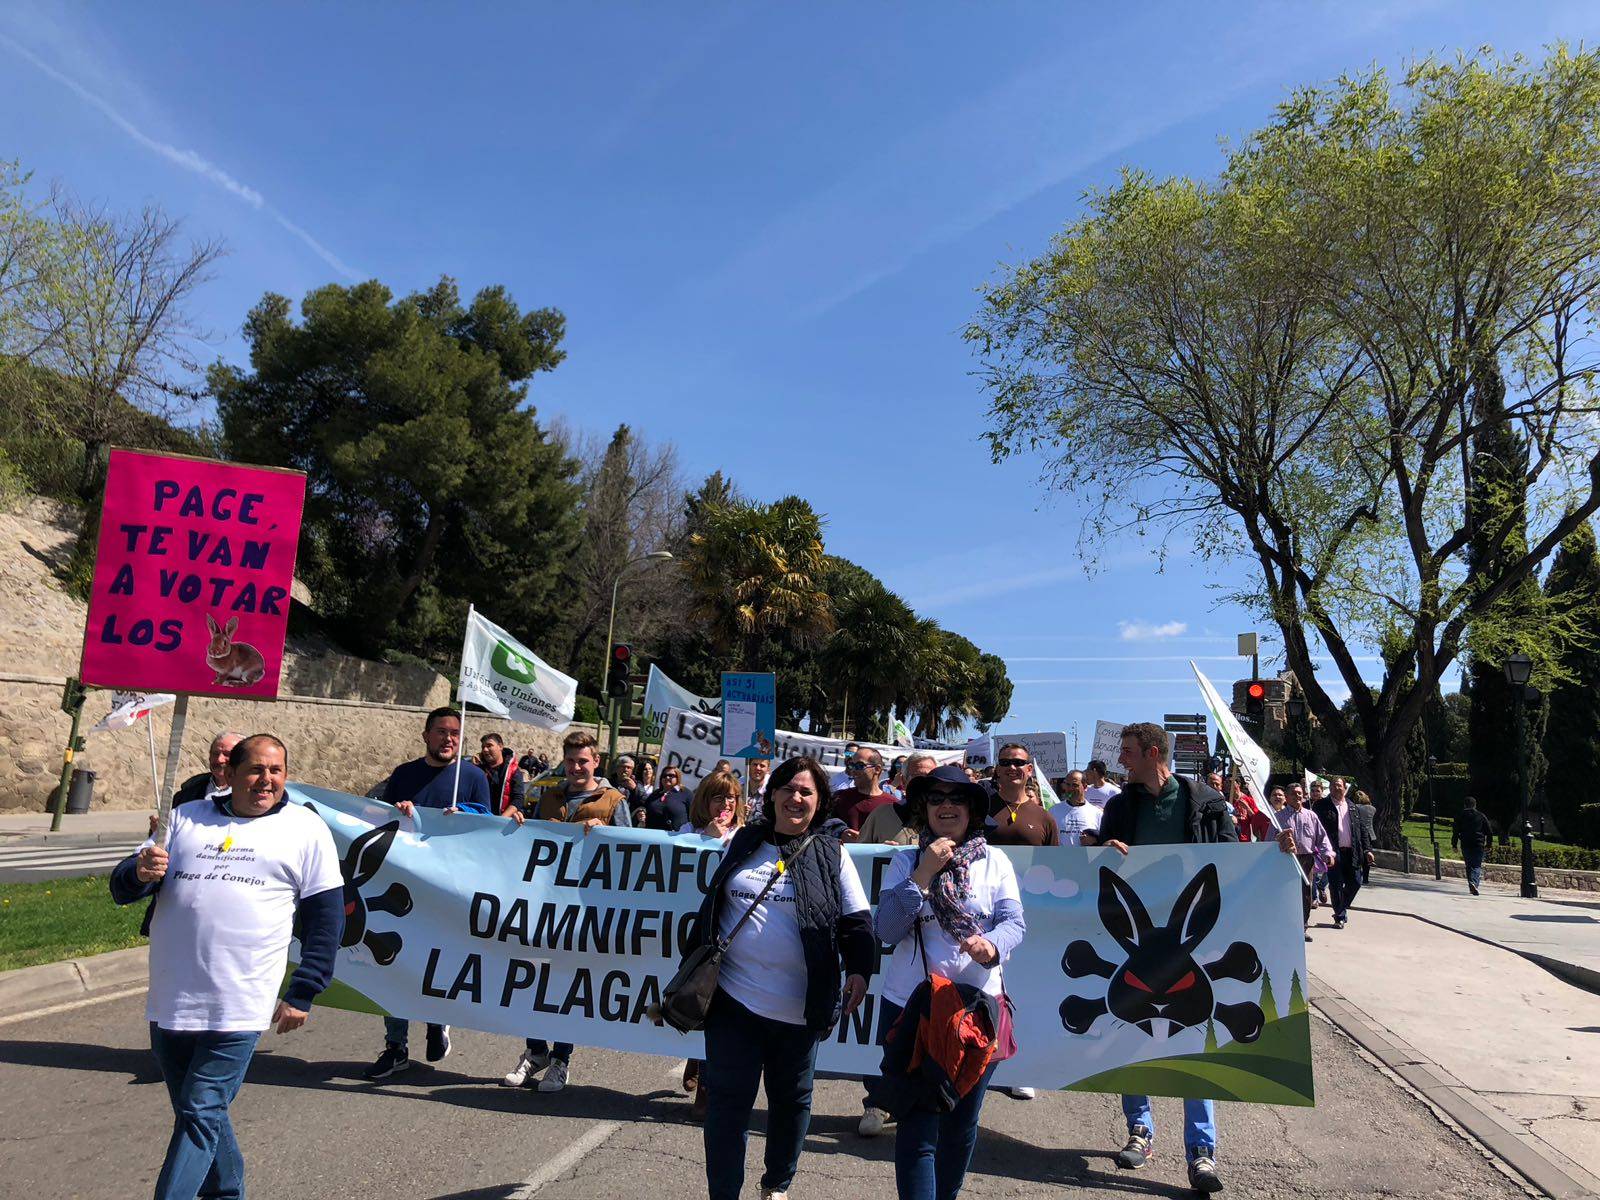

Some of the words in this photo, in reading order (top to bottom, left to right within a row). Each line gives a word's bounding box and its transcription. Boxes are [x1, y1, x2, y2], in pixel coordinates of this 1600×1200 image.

[153, 480, 279, 531] PAGE,
[120, 524, 174, 555] TE
[188, 529, 271, 570] VAN
[108, 563, 135, 596] A
[159, 569, 287, 616] VOTAR
[101, 614, 183, 652] LOS
[493, 681, 508, 693] de
[511, 686, 558, 713] Uniones
[516, 702, 560, 723] Ganaderos
[677, 713, 721, 745] LOS
[667, 751, 704, 779] DEL
[173, 871, 202, 881] Plaga
[204, 872, 219, 880] de
[221, 872, 266, 886] Conejos
[522, 838, 723, 897] PLATAFO
[469, 890, 700, 958] DAMNIFIC
[421, 948, 482, 1003] LA
[499, 958, 664, 1027] PLAGA
